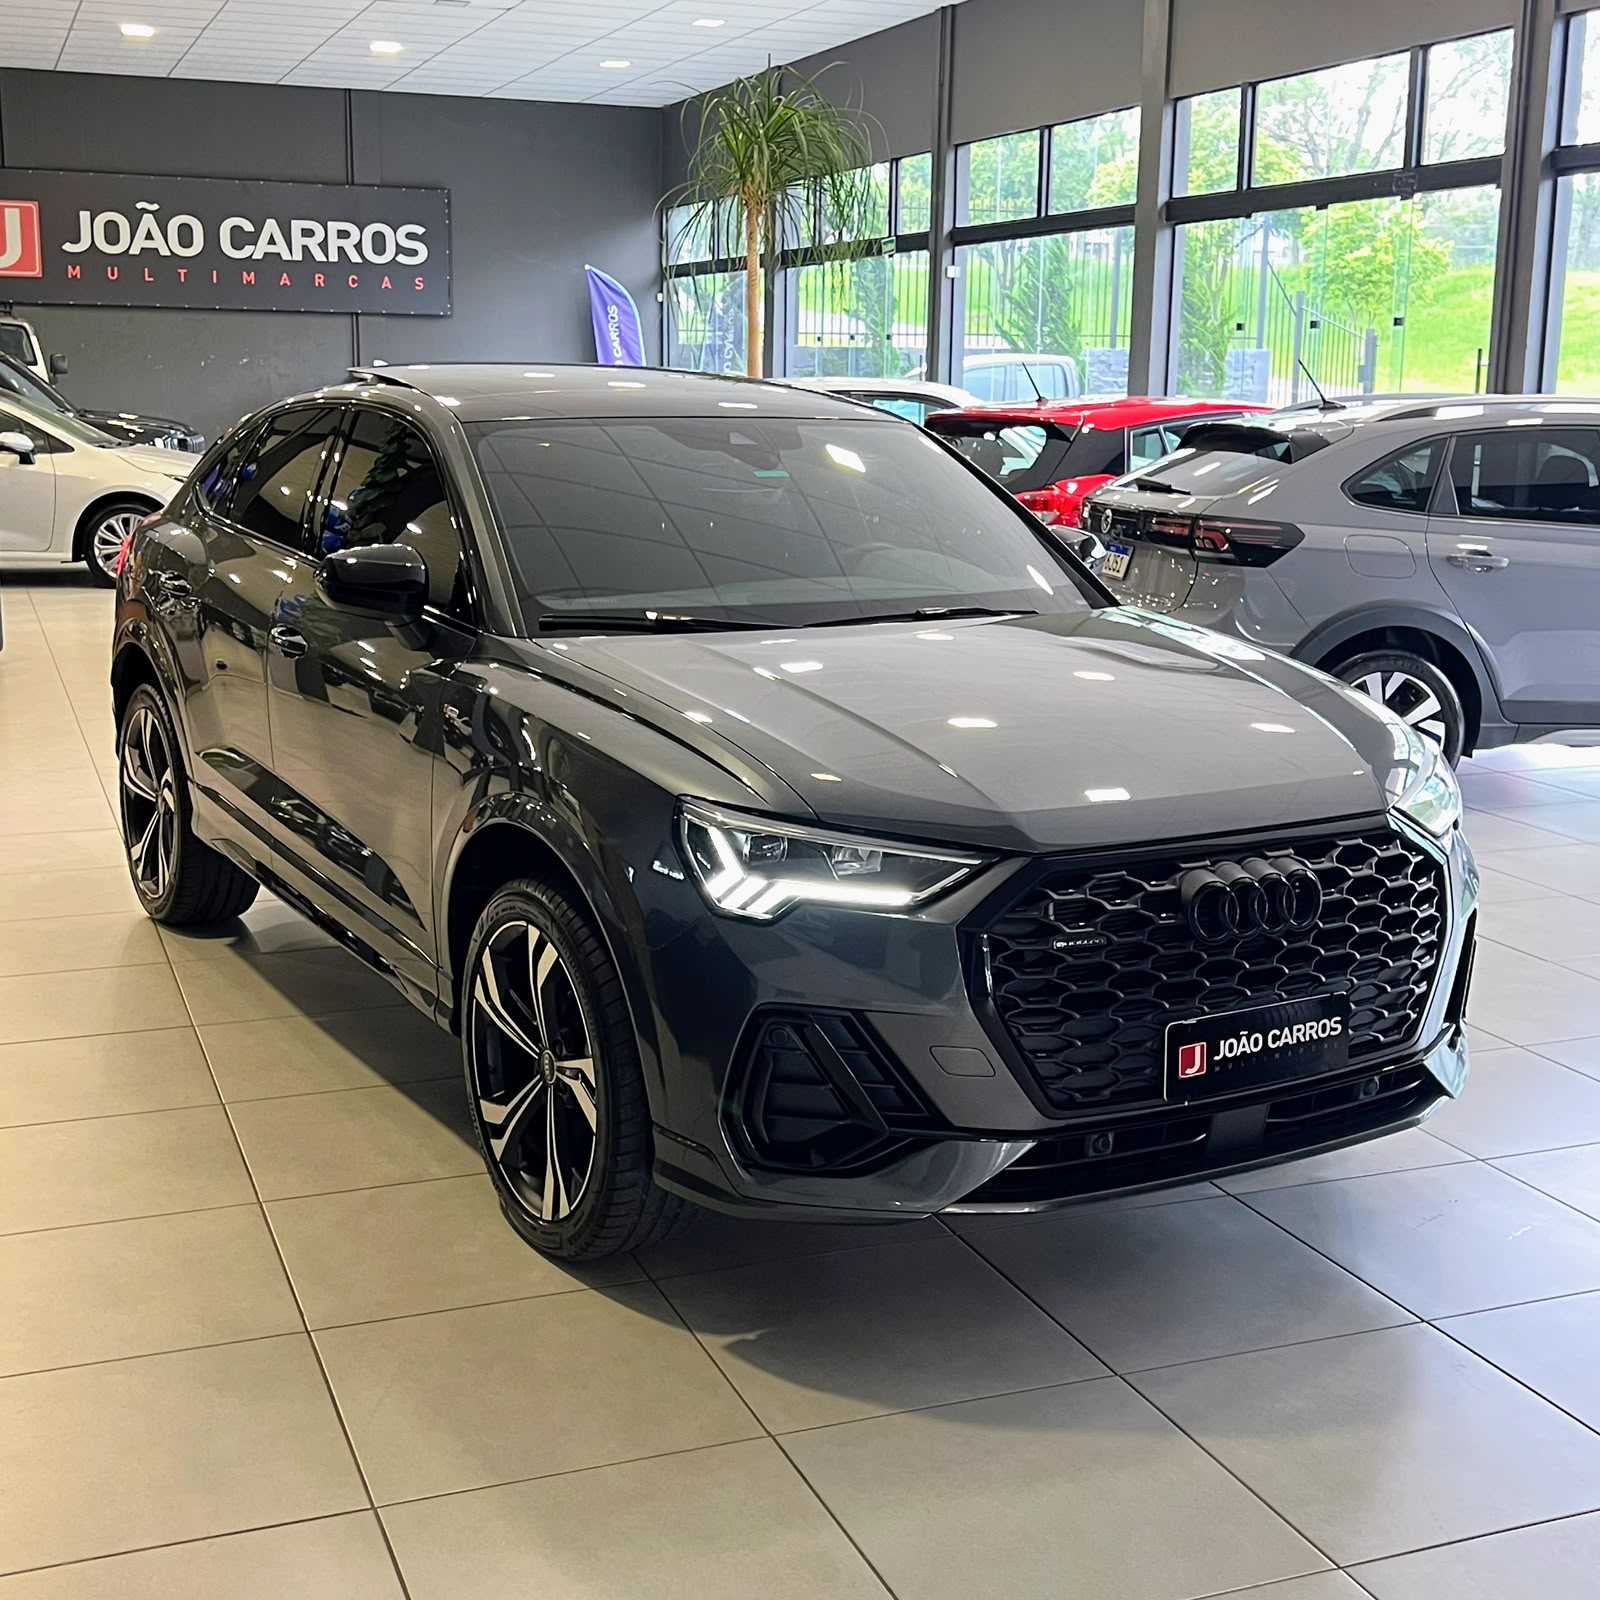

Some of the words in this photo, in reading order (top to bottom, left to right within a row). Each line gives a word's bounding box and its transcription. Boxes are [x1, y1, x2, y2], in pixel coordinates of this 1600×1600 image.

[61, 201, 204, 258] JOÃO
[219, 216, 429, 266] CARROS
[67, 264, 425, 290] MULTIMARCAS
[607, 303, 622, 358] CARROS
[1184, 1045, 1201, 1075] J
[1213, 1031, 1263, 1061] JOÃO
[1267, 1016, 1342, 1049] CARROS
